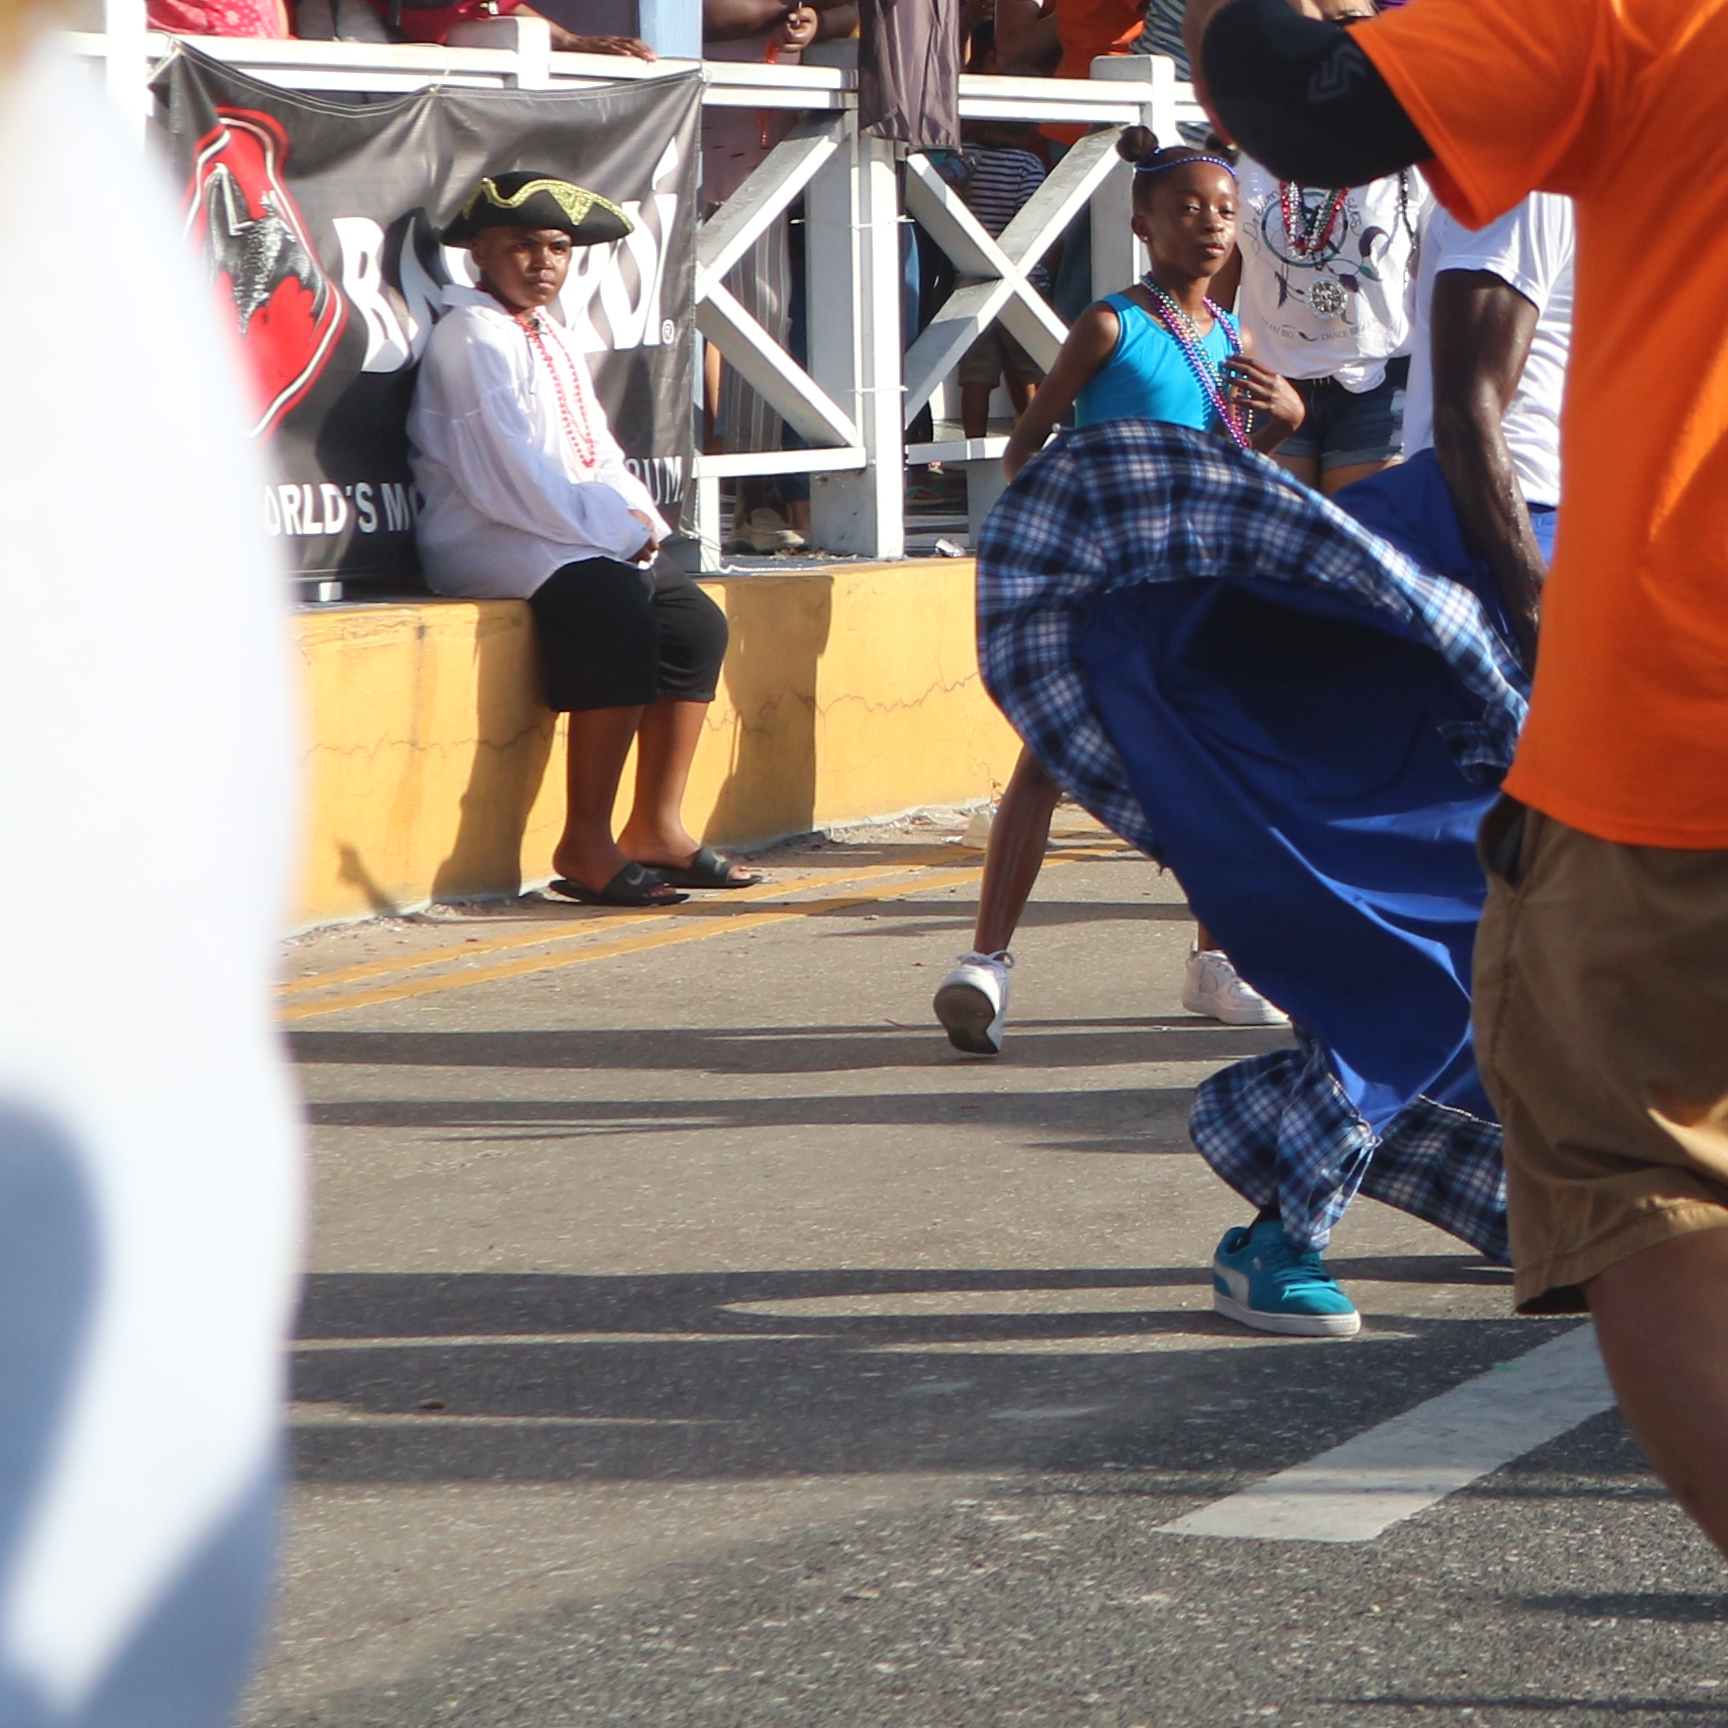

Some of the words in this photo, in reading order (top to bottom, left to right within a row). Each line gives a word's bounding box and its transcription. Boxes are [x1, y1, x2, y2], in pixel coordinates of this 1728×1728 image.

[333, 136, 679, 373] BARDÍ
[264, 482, 378, 536] ORLD'S
[380, 482, 423, 532] MO
